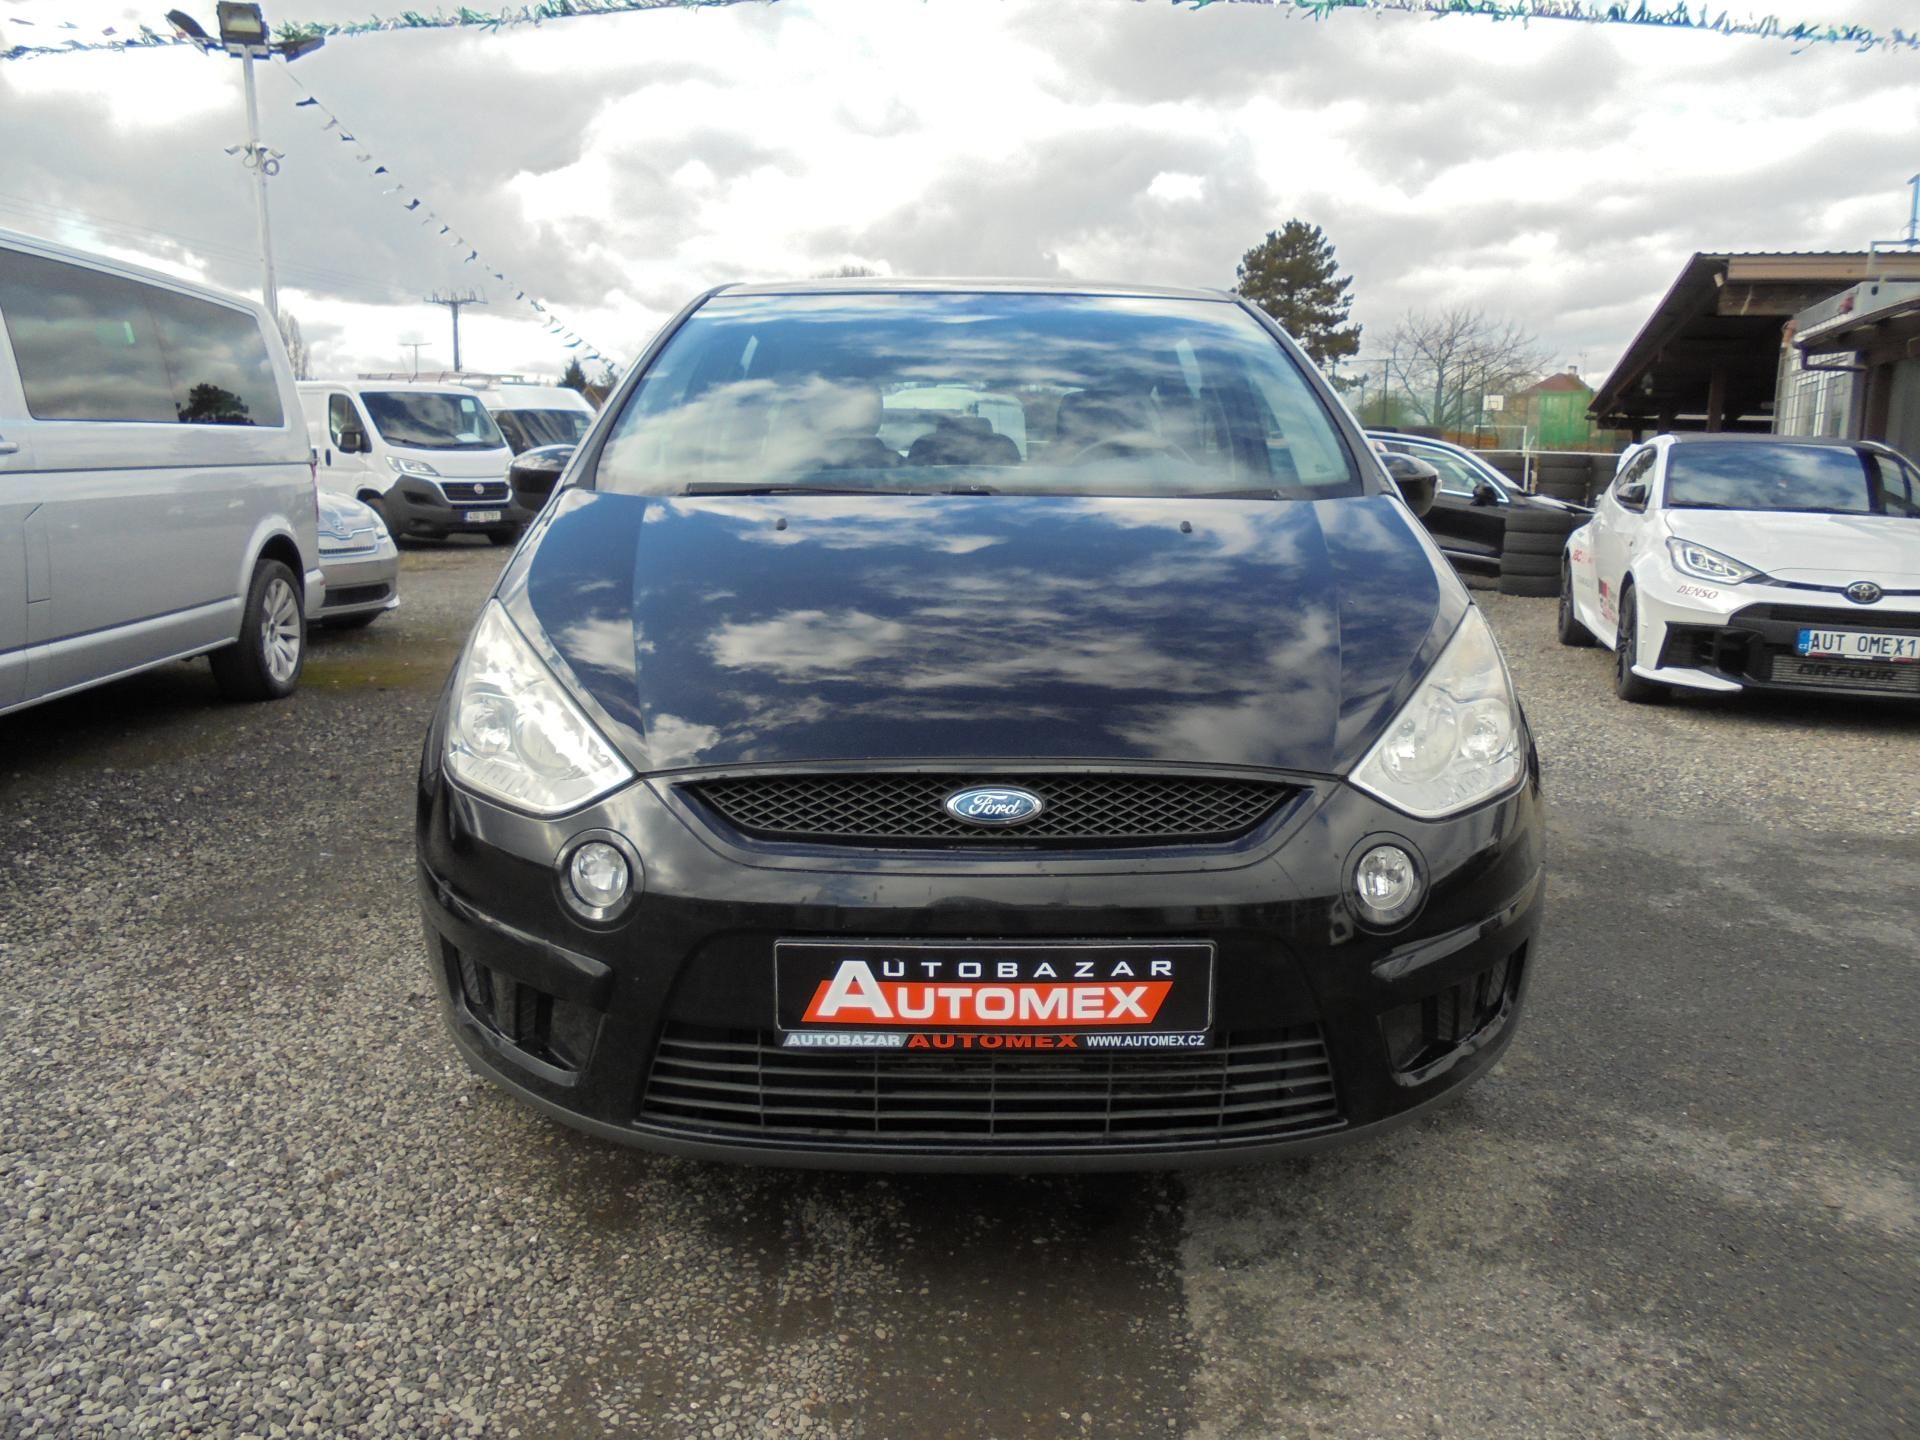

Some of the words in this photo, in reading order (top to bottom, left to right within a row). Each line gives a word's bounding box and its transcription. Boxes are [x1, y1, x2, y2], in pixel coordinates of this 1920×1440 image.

[1677, 585, 1719, 600] DENSO
[1811, 633, 1846, 651] AUT
[1857, 636, 1916, 656] OMEX1
[968, 794, 1021, 815] Ford
[815, 960, 1149, 1020] AUTOMEX
[787, 1033, 901, 1047] AUTOBAZAR
[907, 1033, 1079, 1049] AUTOMEX
[1086, 1034, 1206, 1047] WWW.AUTOMEX.CZ
